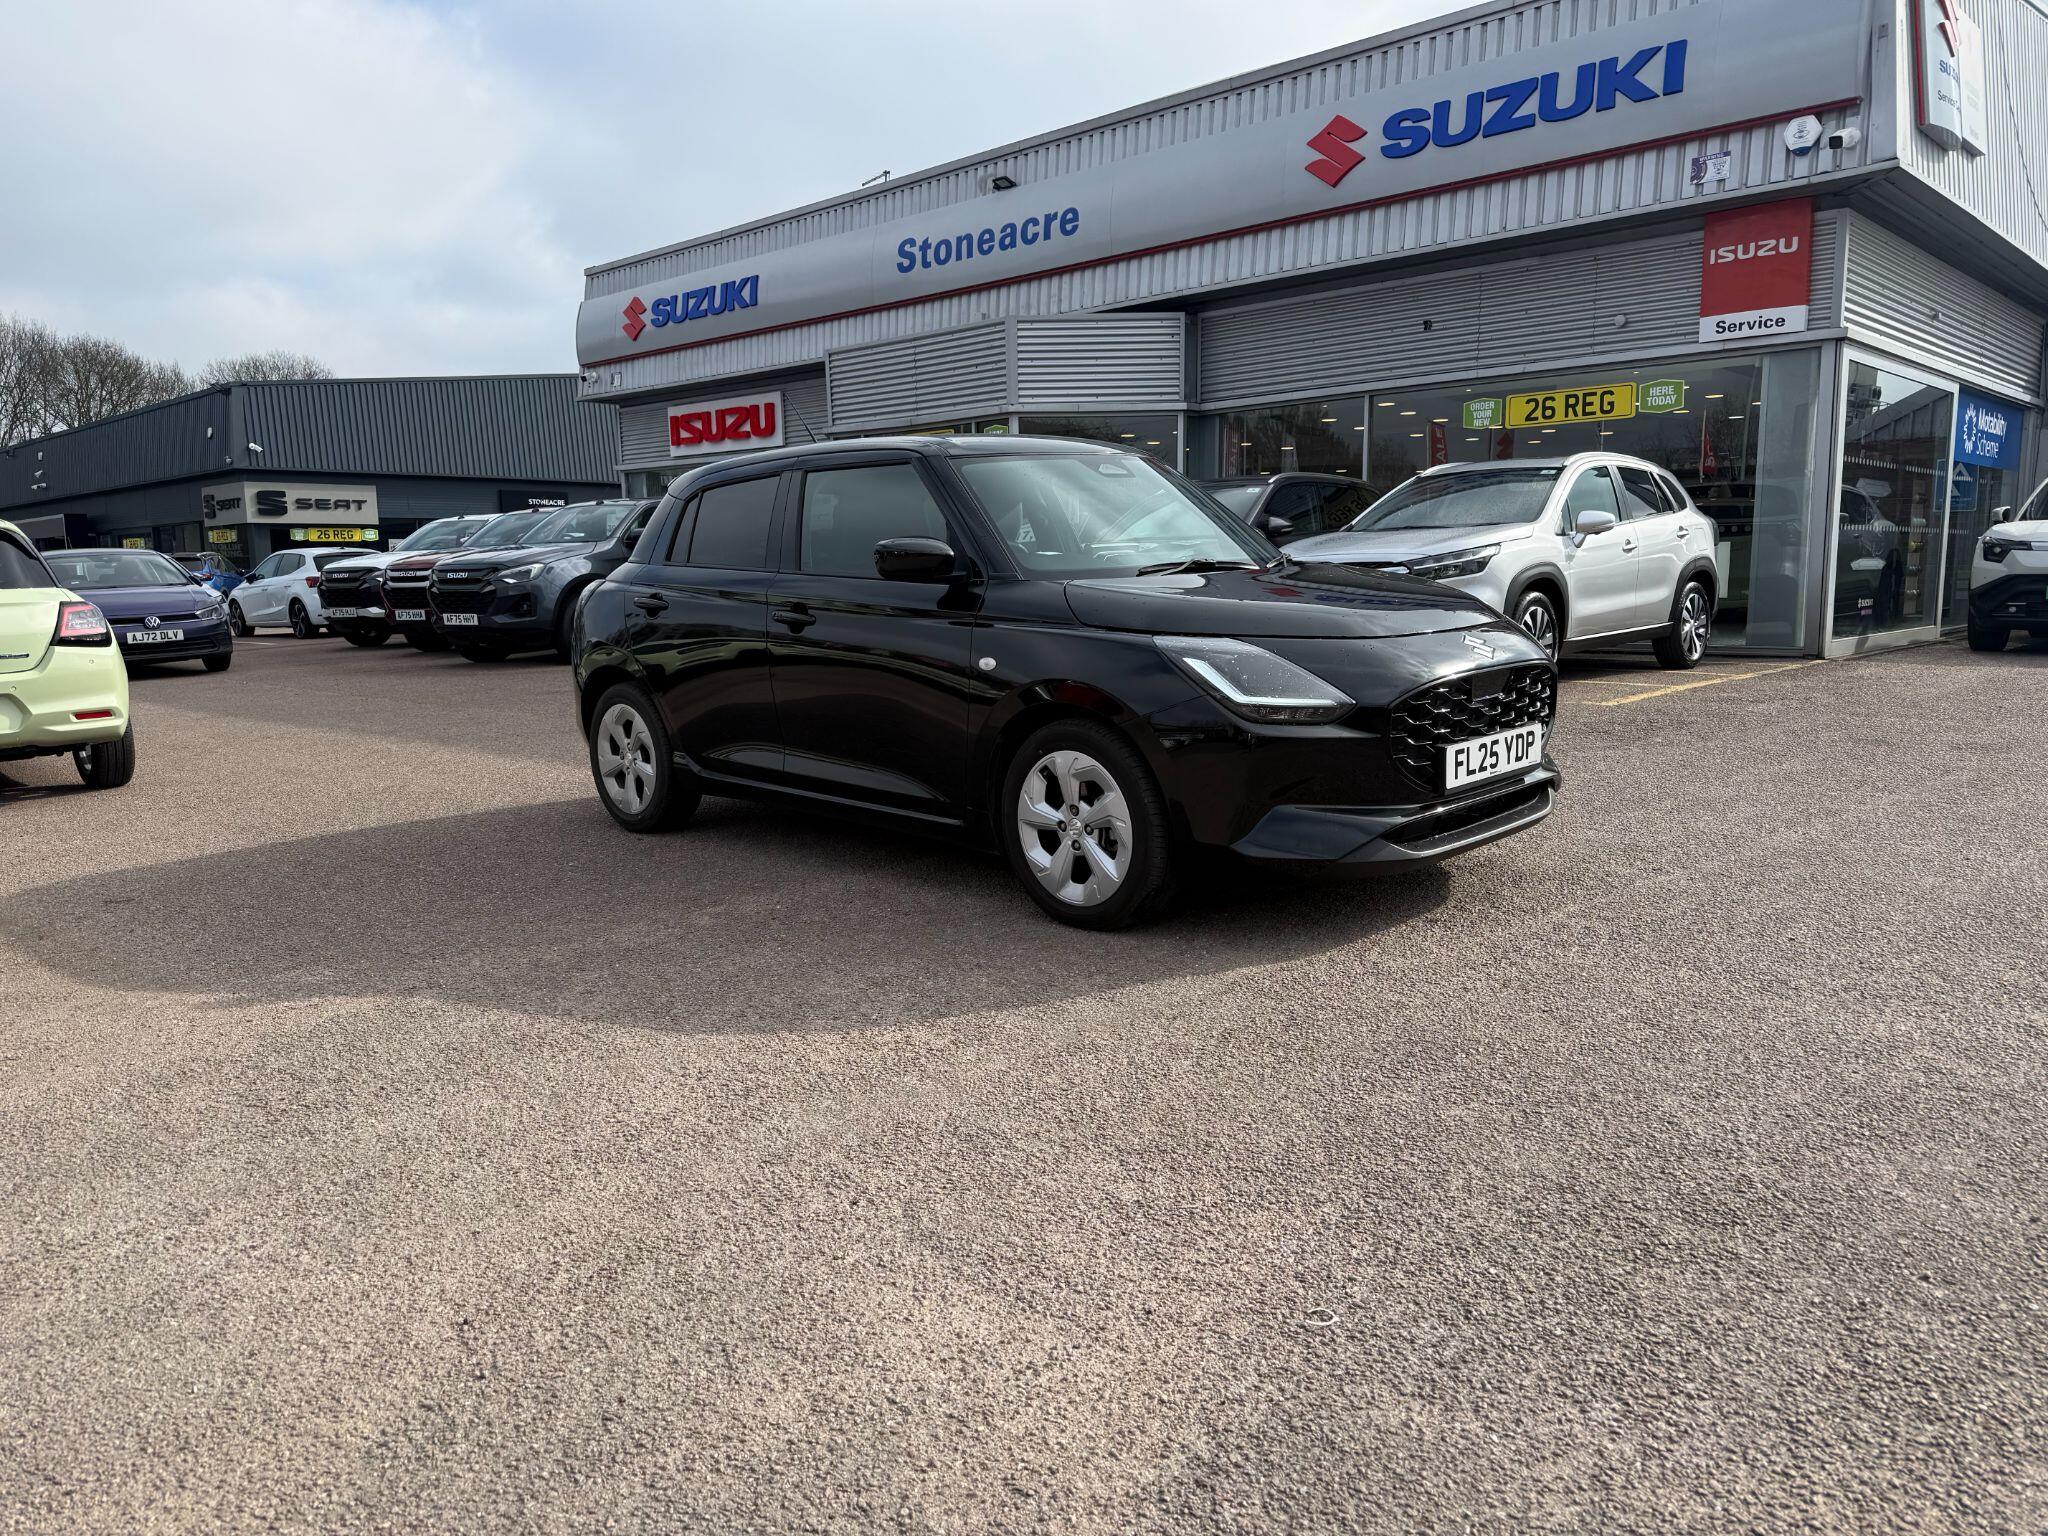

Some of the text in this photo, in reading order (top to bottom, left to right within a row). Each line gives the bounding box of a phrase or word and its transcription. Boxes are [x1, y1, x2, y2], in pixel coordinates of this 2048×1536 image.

[1380, 39, 1688, 160] SUZUKI
[896, 207, 1080, 274] Stoneacre
[1709, 236, 1799, 265] ISUZU
[650, 275, 759, 328] SUZUKI
[1715, 315, 1786, 335] Service
[1649, 386, 1675, 398] HERE
[1470, 401, 1495, 412] ORDER
[1524, 389, 1616, 422] 26 REG
[1647, 395, 1677, 407] TODAY
[1472, 409, 1492, 419] YOUR
[1473, 418, 1490, 427] NEW
[669, 403, 776, 447] ISUZU
[1978, 407, 2007, 442] Motability
[1435, 428, 1447, 463] ALE
[1976, 433, 1999, 459] Scheme
[216, 497, 241, 511] SEAT
[293, 498, 368, 511] SEAT
[528, 498, 566, 506] STONEACRE
[316, 529, 331, 540] 26
[333, 529, 354, 540] REG
[447, 614, 462, 624] AF75
[132, 630, 178, 643] AJ72 DLV
[1454, 730, 1536, 780] FL25 YDP
